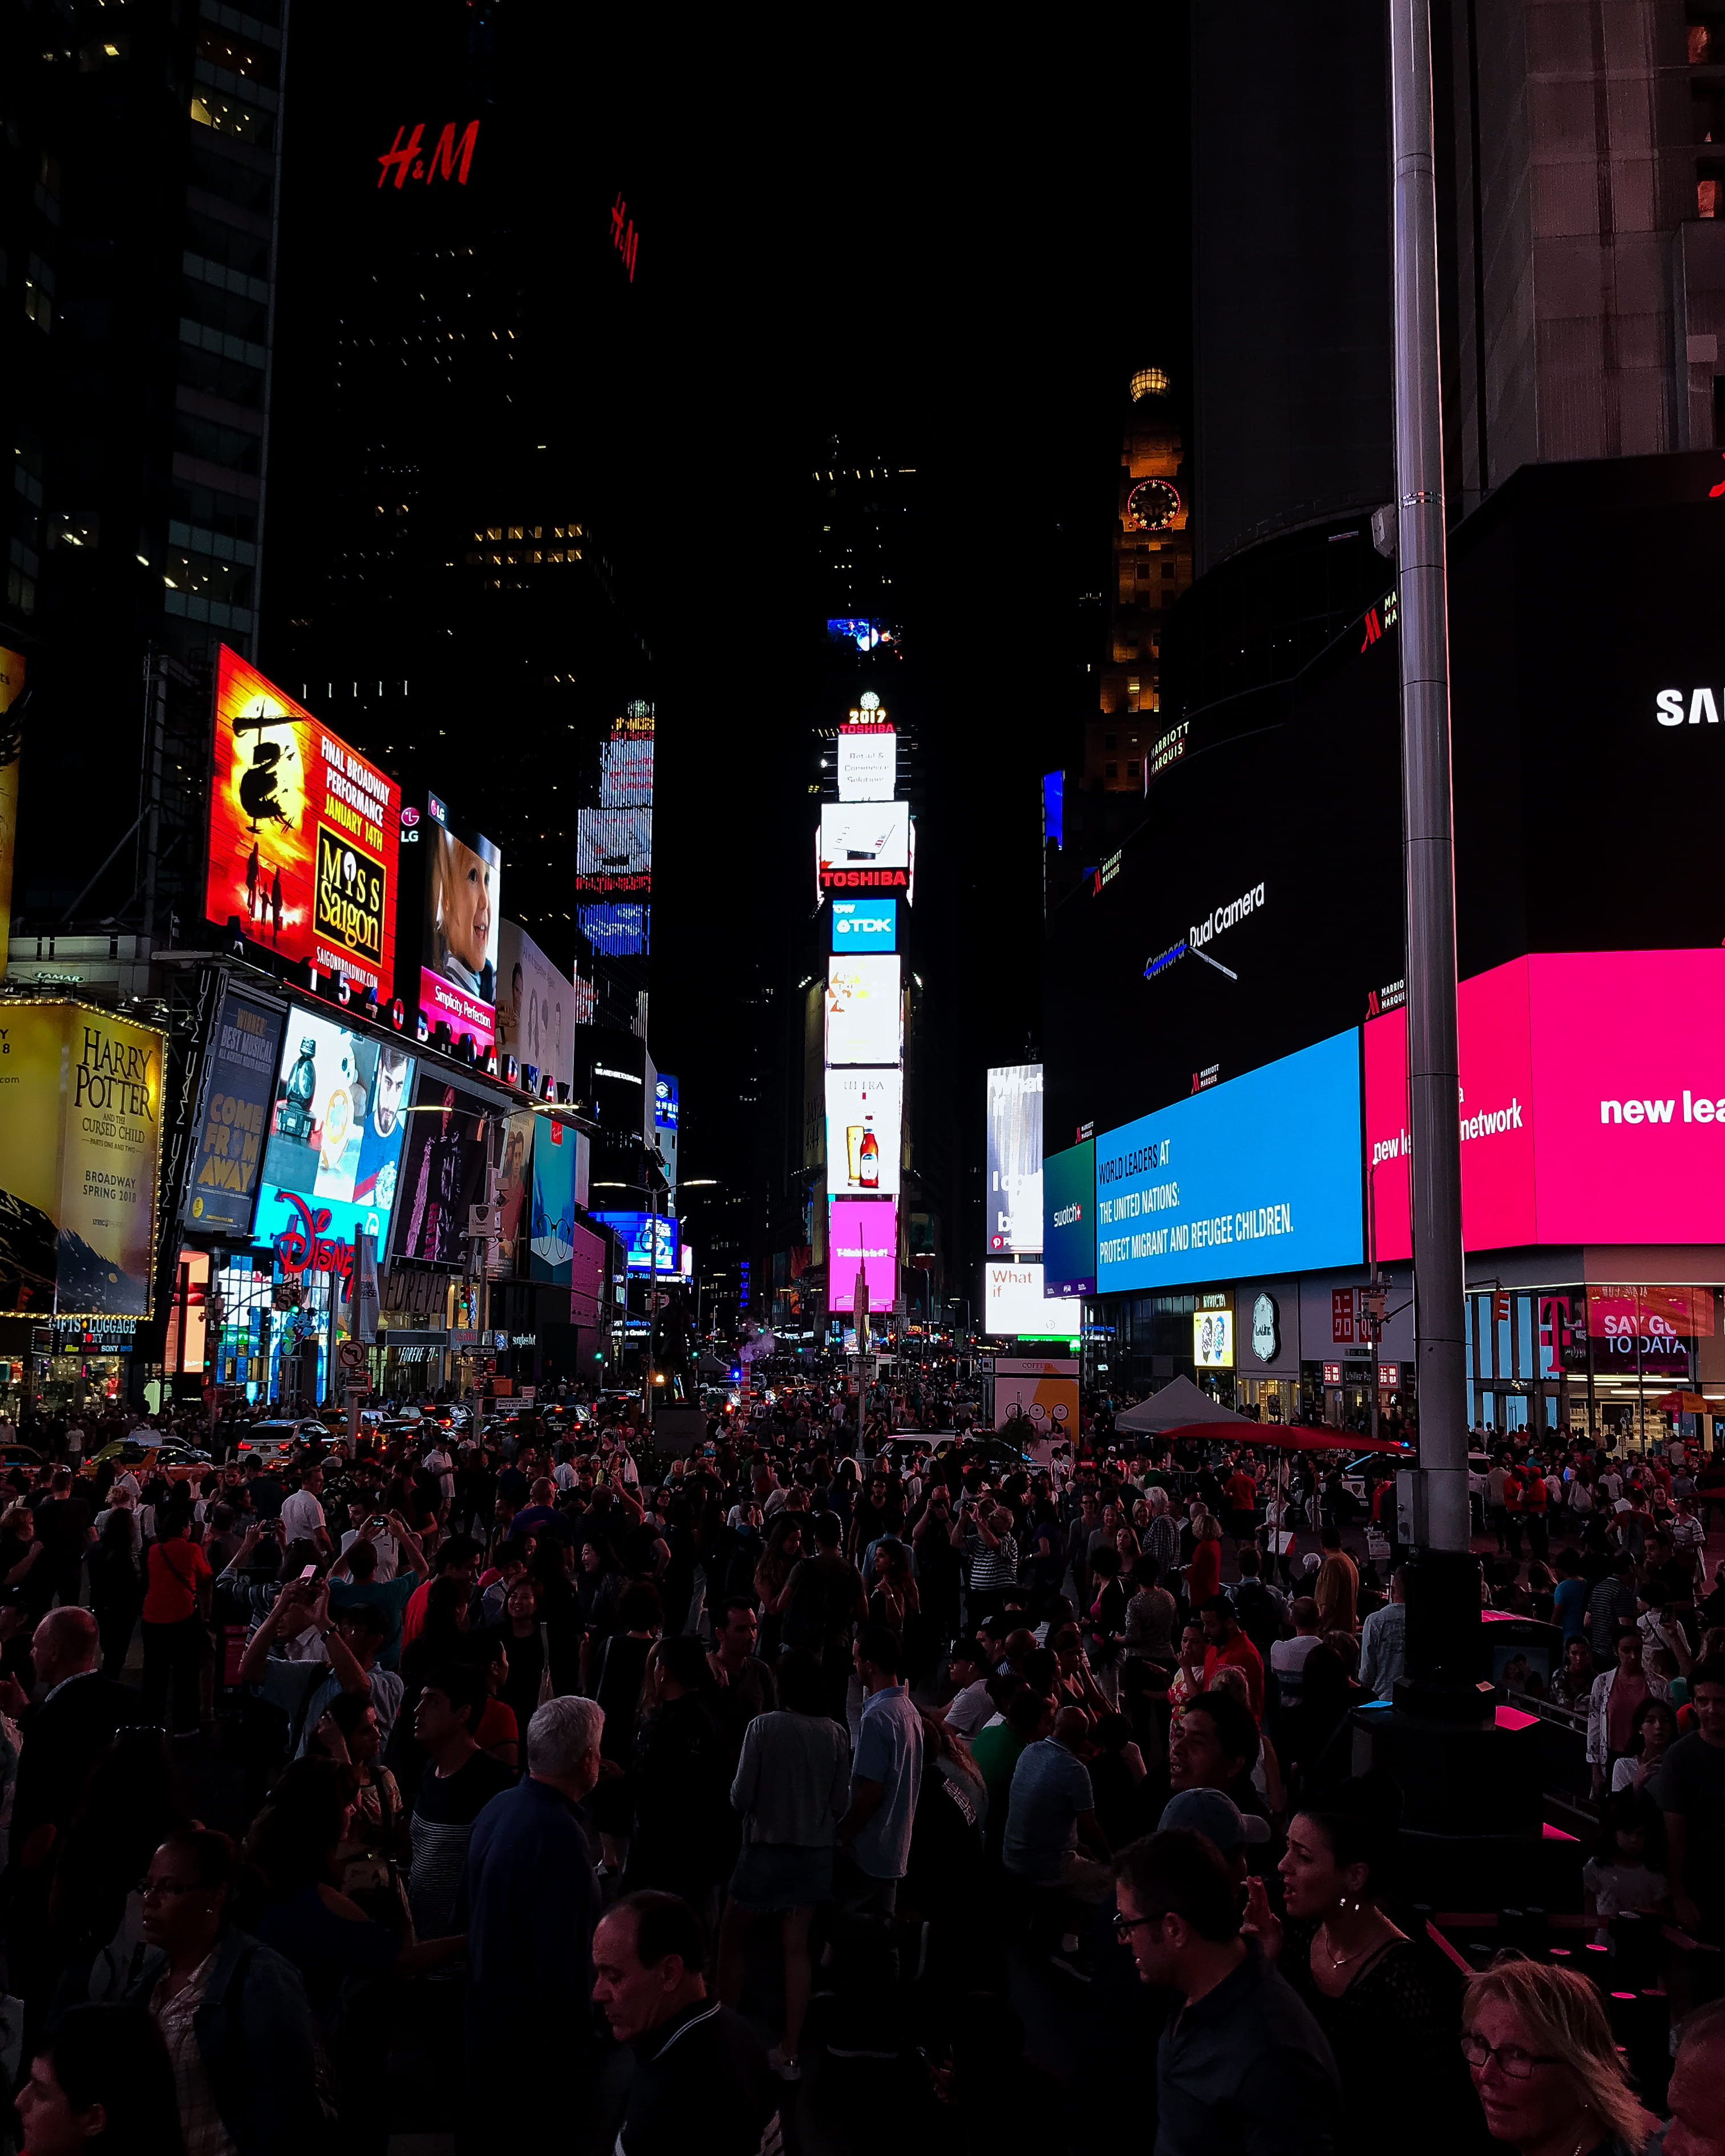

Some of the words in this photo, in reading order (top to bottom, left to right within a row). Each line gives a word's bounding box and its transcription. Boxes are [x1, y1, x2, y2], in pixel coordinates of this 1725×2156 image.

[378, 120, 480, 189] H&M
[849, 710, 886, 724] 2017
[1656, 687, 1725, 727] SA
[840, 724, 894, 734] TOSHIBA
[1151, 721, 1189, 760] MARRIOTT
[321, 735, 345, 773] FINAL
[347, 756, 390, 806] BROADWAY
[1151, 742, 1183, 776] MARQUIS
[326, 766, 384, 828] PERFORMANCE
[324, 793, 361, 837] JANUARY
[365, 821, 383, 852] 14TH
[400, 830, 419, 842] LG
[821, 871, 907, 887] TOSHIBA
[319, 880, 379, 953] Saigon
[848, 918, 893, 933] TDK
[1190, 913, 1213, 947] Dual
[1214, 882, 1264, 934] Camera
[37, 972, 81, 982] LAMAR
[317, 945, 378, 989] SAIGONBROADWAY.COM
[1381, 979, 1405, 997] MARRIO
[435, 985, 463, 1017] Simplicity.
[464, 1003, 492, 1029] Perfection.
[82, 1026, 153, 1085] HARRY
[75, 1064, 155, 1122] POTTER
[210, 1093, 265, 1134] COME
[1460, 1097, 1523, 1141] network
[1601, 1100, 1675, 1124] new
[82, 1117, 116, 1138] CURSED
[118, 1126, 146, 1144] CHILD
[1098, 1156, 1123, 1186] WORLD
[1124, 1144, 1158, 1178] LEADERS
[1159, 1138, 1171, 1166] AT
[1374, 1137, 1399, 1162] new
[85, 1170, 136, 1189] BROADWAY
[197, 1154, 256, 1193] AWAY
[83, 1184, 116, 1200] SPRING
[119, 1190, 137, 1203] 2018
[1100, 1200, 1112, 1225] THE
[1113, 1192, 1140, 1222] UNITED
[1141, 1181, 1180, 1214] NATIONS:
[1054, 1202, 1077, 1227] swatch
[1100, 1237, 1130, 1265] PROTECT
[1131, 1228, 1168, 1260] MIGRANT
[1169, 1222, 1189, 1253] AND
[1191, 1215, 1233, 1249] REFUGEE
[1235, 1202, 1294, 1242] CHILDREN.
[993, 1270, 1032, 1283] What
[993, 1284, 1002, 1298] if
[52, 1317, 81, 1333] IFTS
[88, 1318, 137, 1334] LUGGAGE
[1603, 1315, 1643, 1334] SAY
[1605, 1335, 1632, 1354] TO
